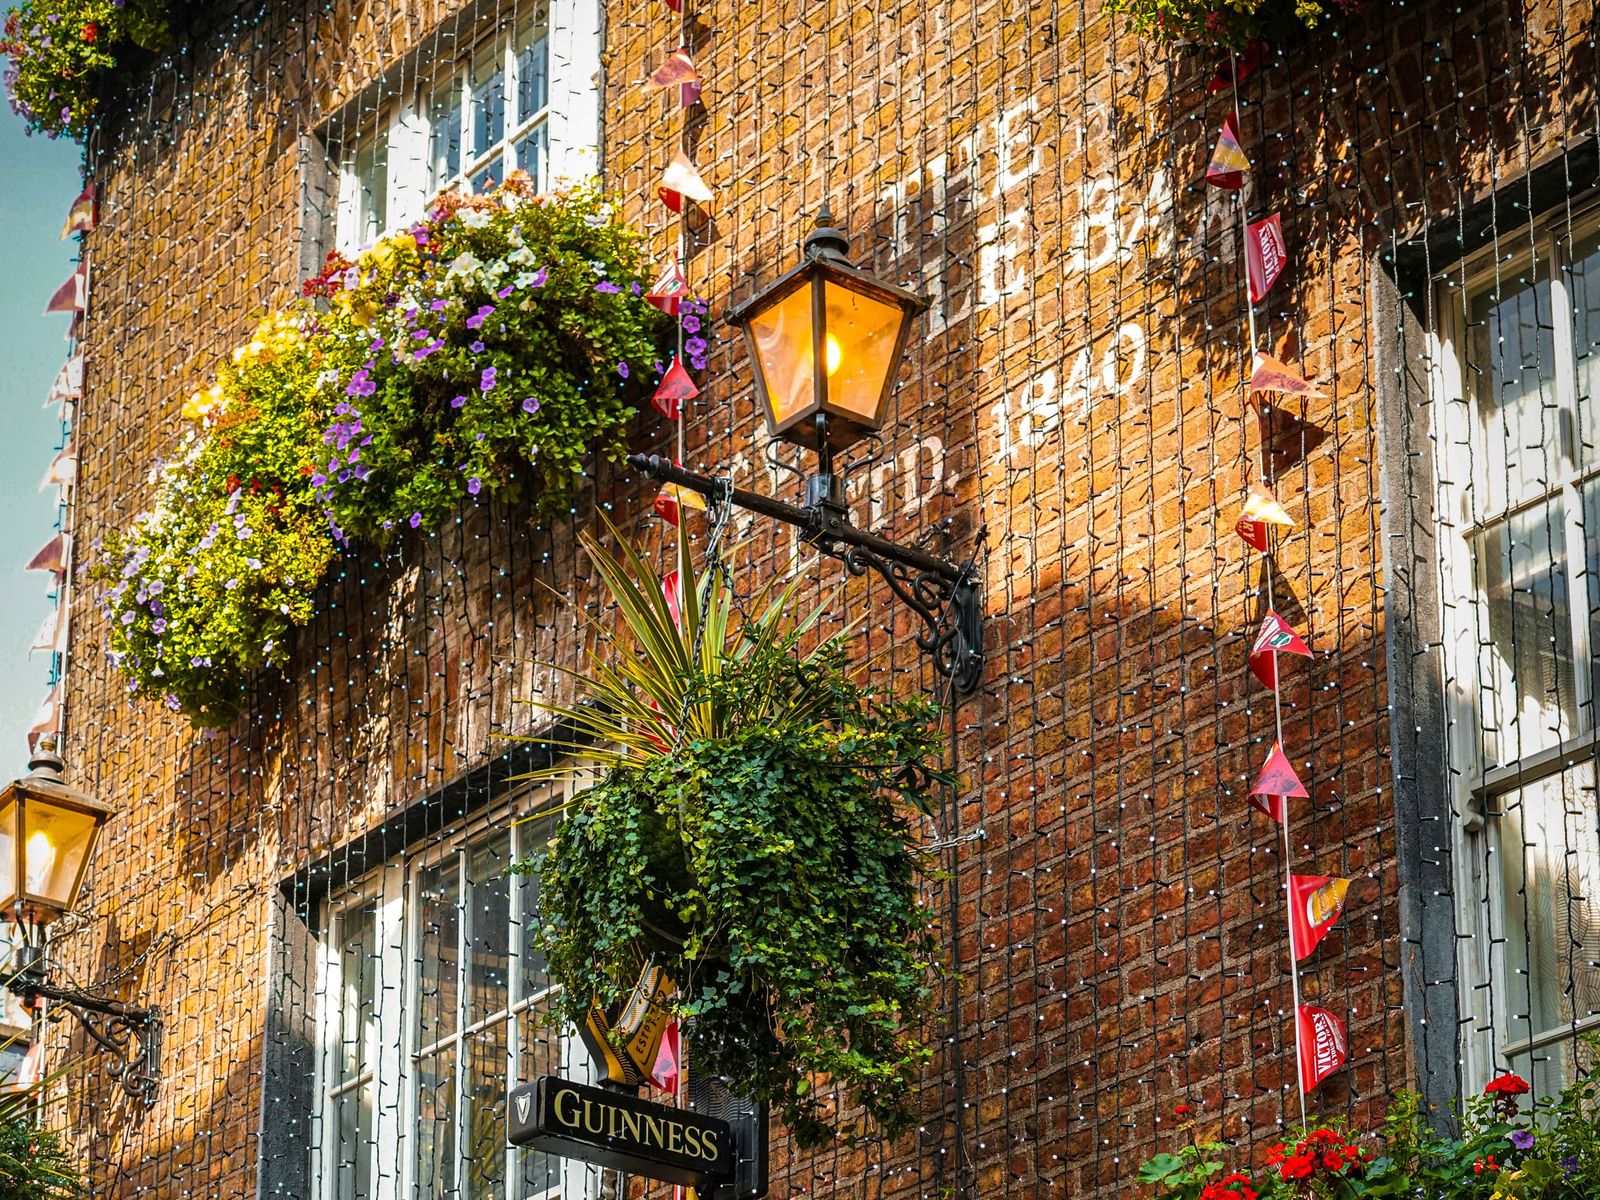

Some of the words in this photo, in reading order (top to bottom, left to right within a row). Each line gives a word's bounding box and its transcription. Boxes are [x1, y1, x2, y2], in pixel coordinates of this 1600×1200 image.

[878, 95, 1041, 262] THE
[1257, 225, 1275, 285] VICTORY
[990, 322, 1145, 466] 1840
[1311, 1012, 1331, 1075] VICTORY
[554, 1088, 718, 1161] GUINNESS
